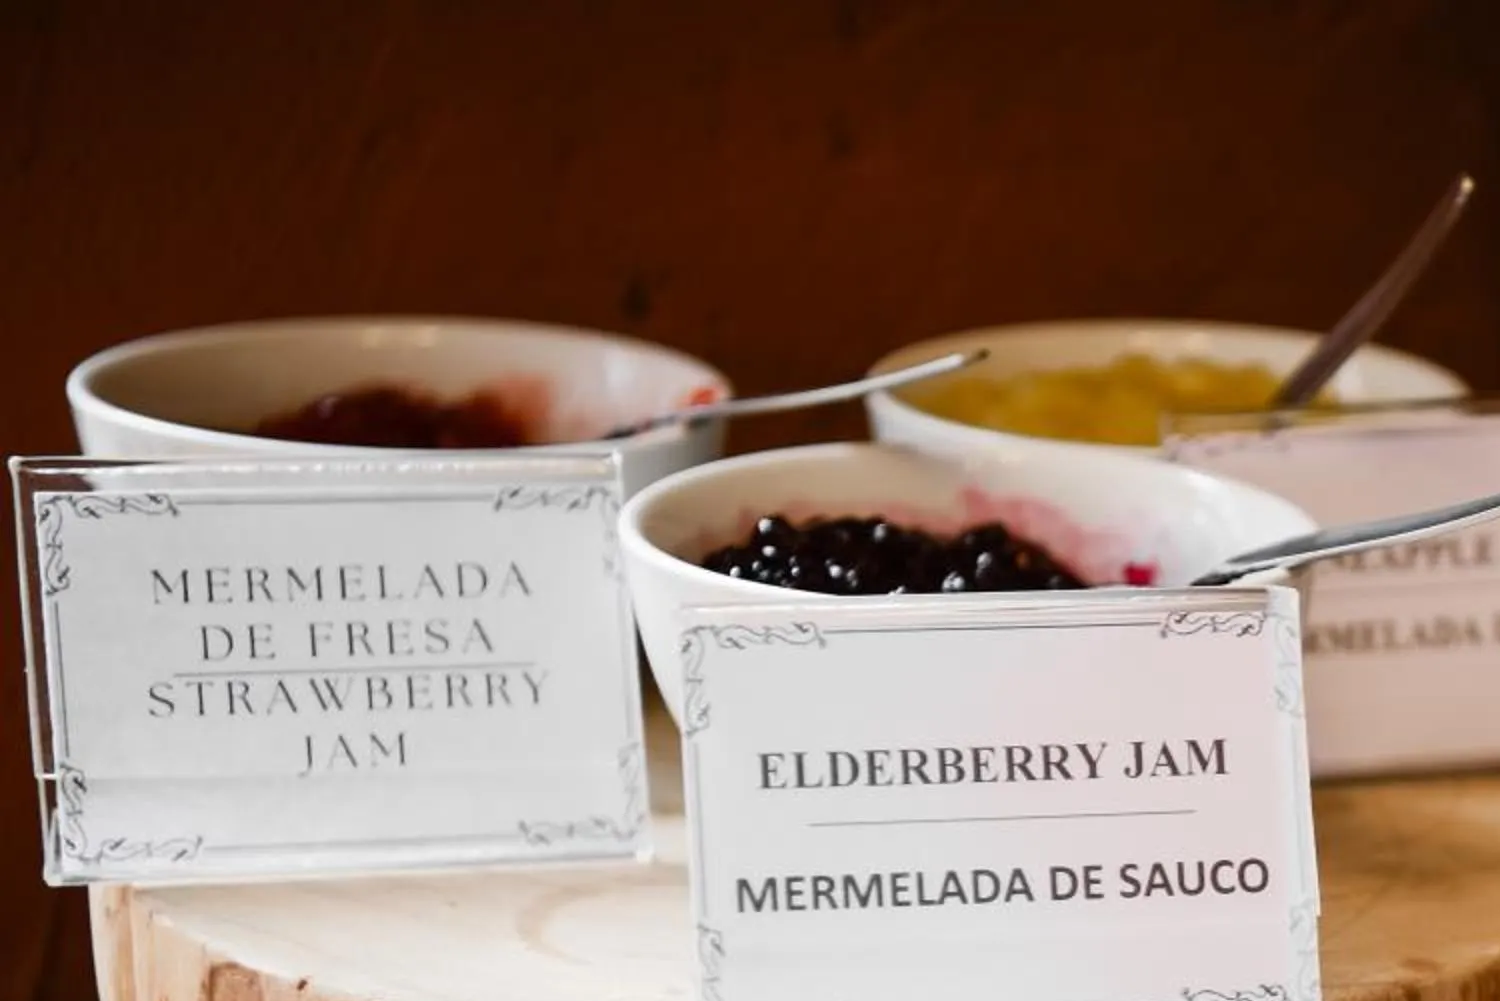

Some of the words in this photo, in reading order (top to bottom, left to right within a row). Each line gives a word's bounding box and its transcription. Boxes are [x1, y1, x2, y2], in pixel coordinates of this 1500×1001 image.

[151, 561, 532, 604] MERMELADA
[200, 622, 277, 662] DE
[307, 617, 495, 659] FRESA
[147, 671, 547, 718] STRAWBERRY
[299, 731, 408, 778] JAM
[757, 741, 1109, 790] ELDERBERRY
[1122, 737, 1230, 780] JAM
[735, 866, 1035, 914] MERMELADA
[1049, 864, 1104, 902] DE
[1118, 856, 1270, 899] SAUCO
